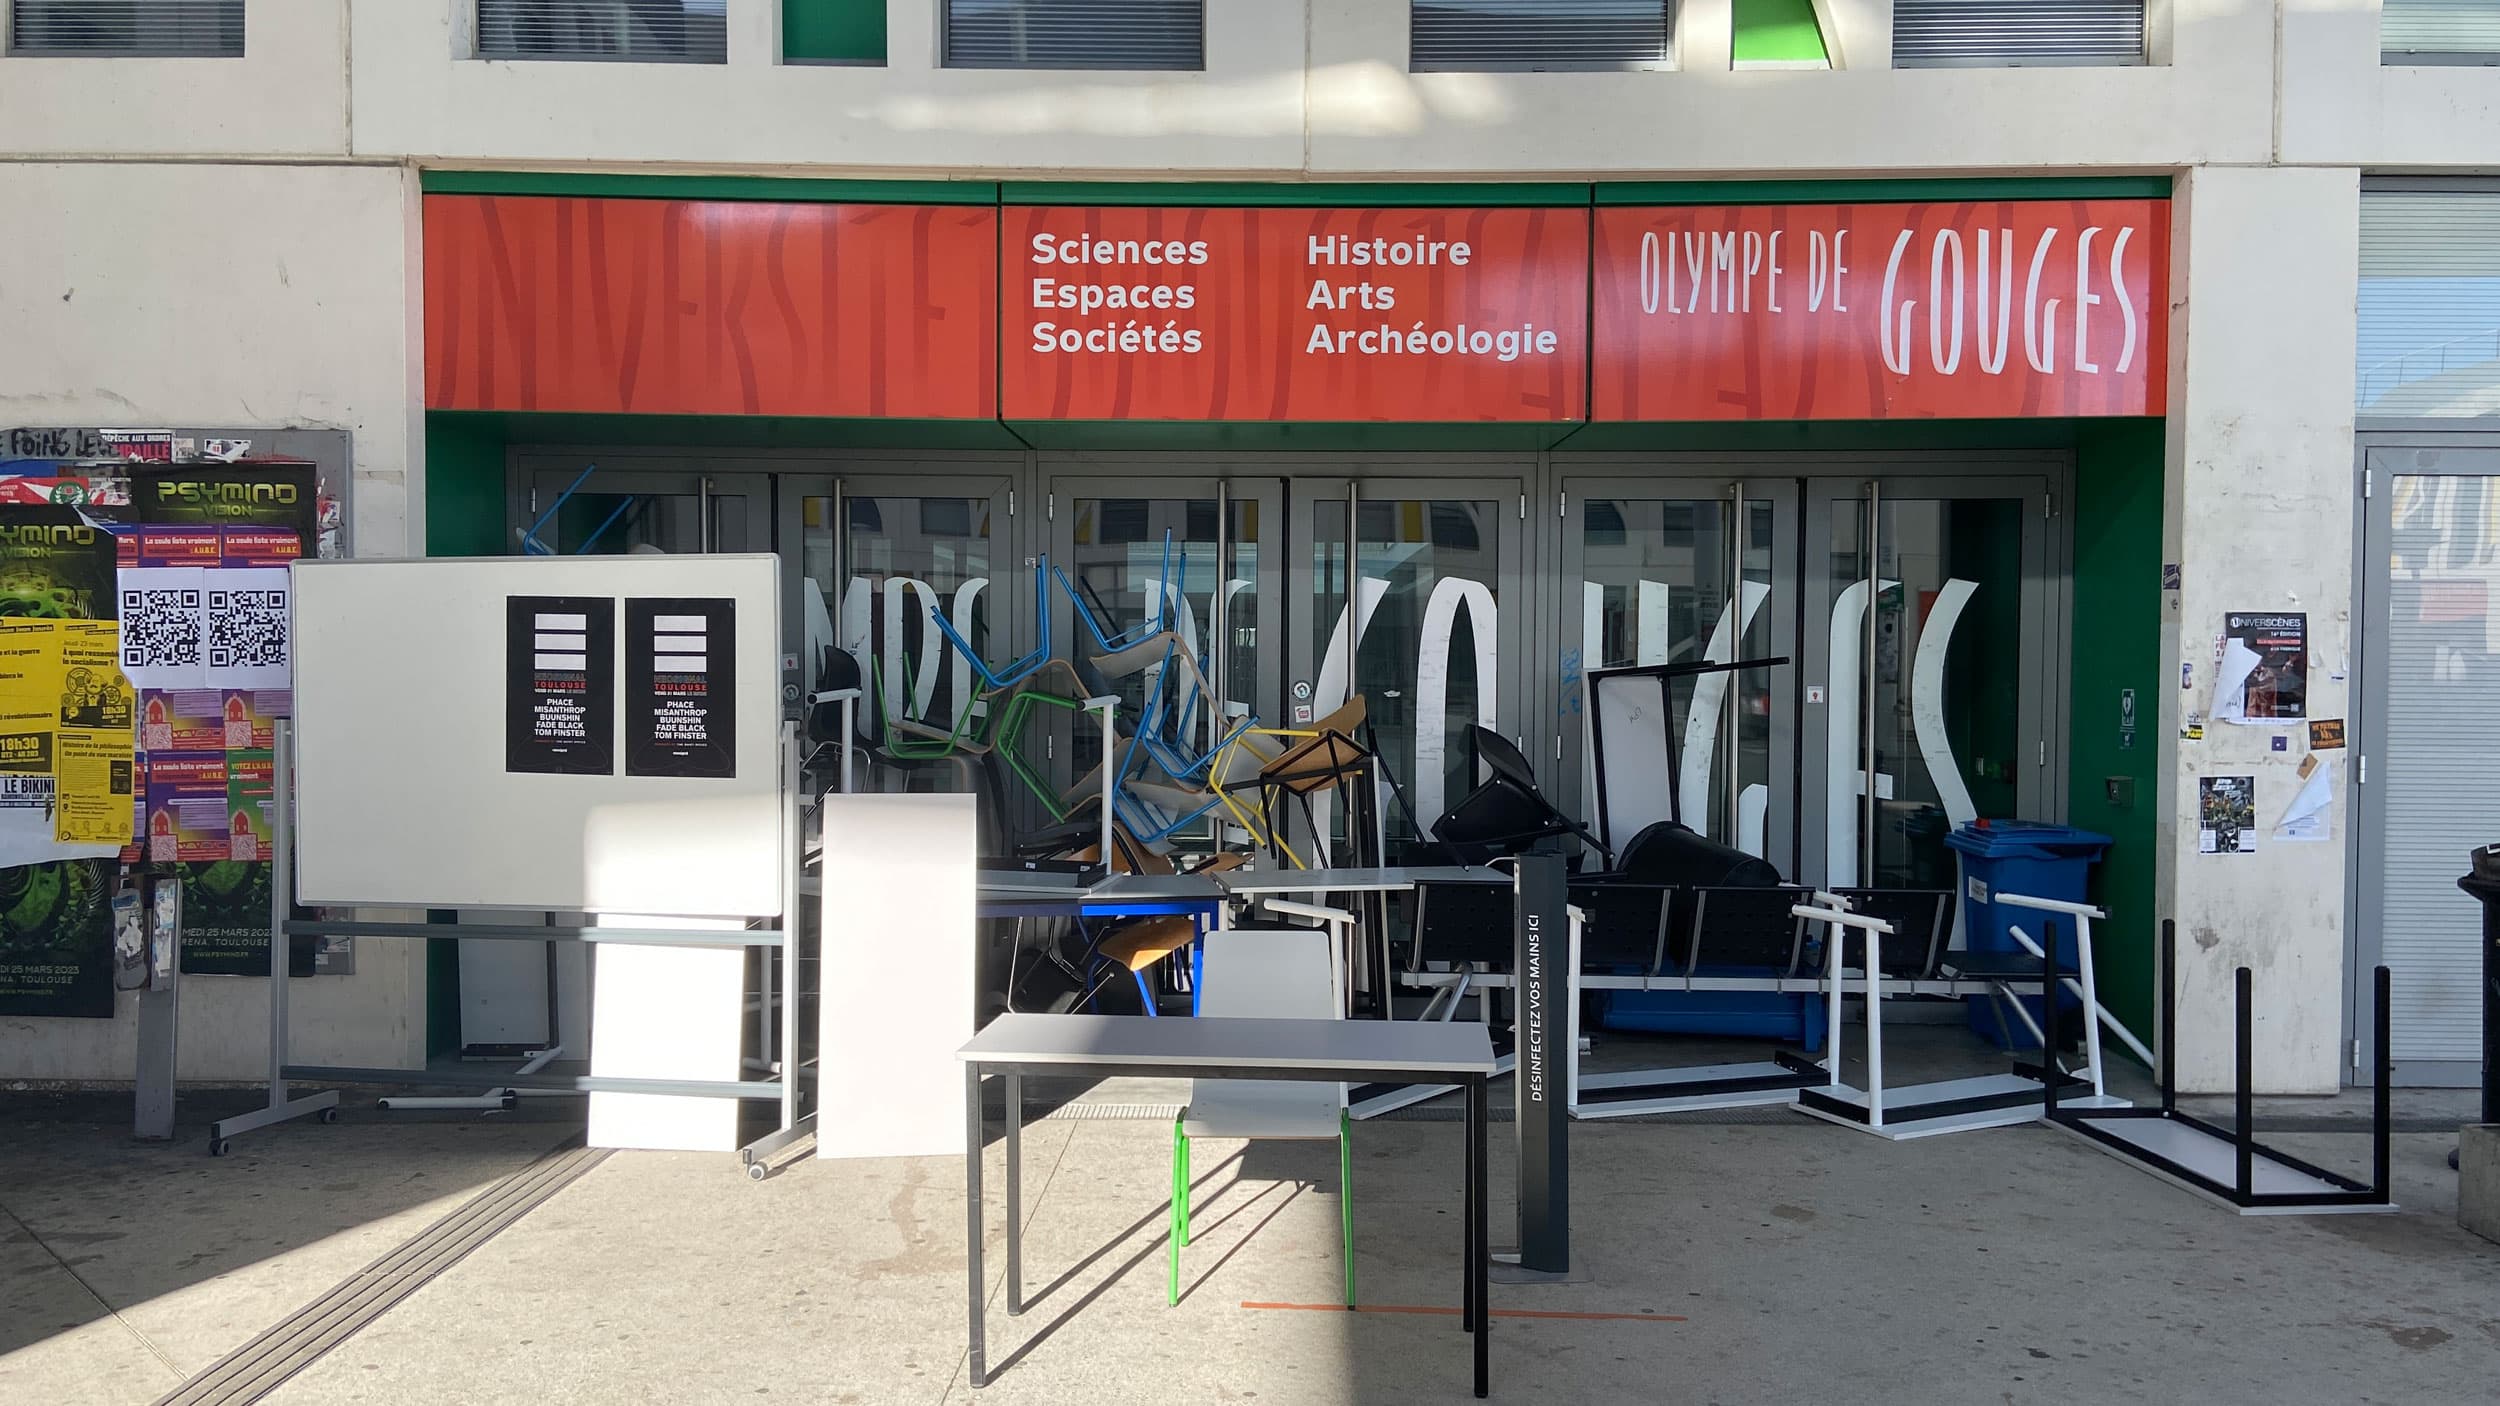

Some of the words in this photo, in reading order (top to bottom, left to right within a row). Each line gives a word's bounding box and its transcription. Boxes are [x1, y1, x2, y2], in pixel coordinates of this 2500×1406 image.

[1031, 233, 1208, 266] Sciences
[1307, 234, 1472, 266] Histoire
[1032, 277, 1196, 316] Espaces
[1306, 279, 1396, 311] Arts
[1640, 230, 1783, 315] OLYMPE
[1808, 229, 1849, 313] DE
[1880, 226, 2137, 376] GOUGES
[1031, 319, 1203, 354] Sociétés
[1305, 319, 1558, 362] Archéologie
[132, 434, 145, 442] AUX
[157, 481, 297, 504] PSYMIND
[202, 505, 254, 517] VISION
[0, 525, 95, 545] YMIND
[145, 537, 153, 545] La
[188, 537, 216, 545] vraiment
[227, 536, 235, 544] La
[269, 536, 297, 544] vraiment
[535, 681, 586, 689] TOULOUSE
[655, 683, 707, 691] TOULOUSE
[546, 698, 574, 706] PHACE
[666, 701, 695, 709] PHACE
[102, 706, 126, 715] 18h30
[534, 705, 586, 714] MISANTHROP
[654, 708, 707, 717] MISANTHROP
[539, 713, 581, 722] BUUNSHIN
[660, 716, 702, 724] BUUNSHIN
[536, 721, 557, 729] FADE
[558, 721, 584, 730] BLACK
[678, 724, 705, 732] BLACK
[534, 728, 552, 736] TOM
[553, 729, 586, 737] FINSTER
[654, 731, 672, 739] TOM
[673, 731, 707, 740] FINSTER
[1, 736, 40, 751] 18h30
[195, 762, 224, 771] vraiment
[5, 779, 17, 794] LE
[21, 779, 55, 794] BIKINI
[1528, 914, 1539, 931] ICI
[181, 928, 205, 937] MEDI
[206, 928, 219, 937] 25
[221, 928, 249, 937] MARS
[181, 938, 209, 947] RENA,
[216, 938, 269, 946] TOULOUSE
[1529, 934, 1540, 978] MAINS
[11, 965, 24, 974] 25
[25, 965, 53, 974] MARS
[54, 965, 80, 975] 2023
[21, 976, 73, 984] TOULOUSE
[1529, 980, 1541, 1009] VOS
[1529, 1011, 1542, 1101] DÉSINFECTEZ
